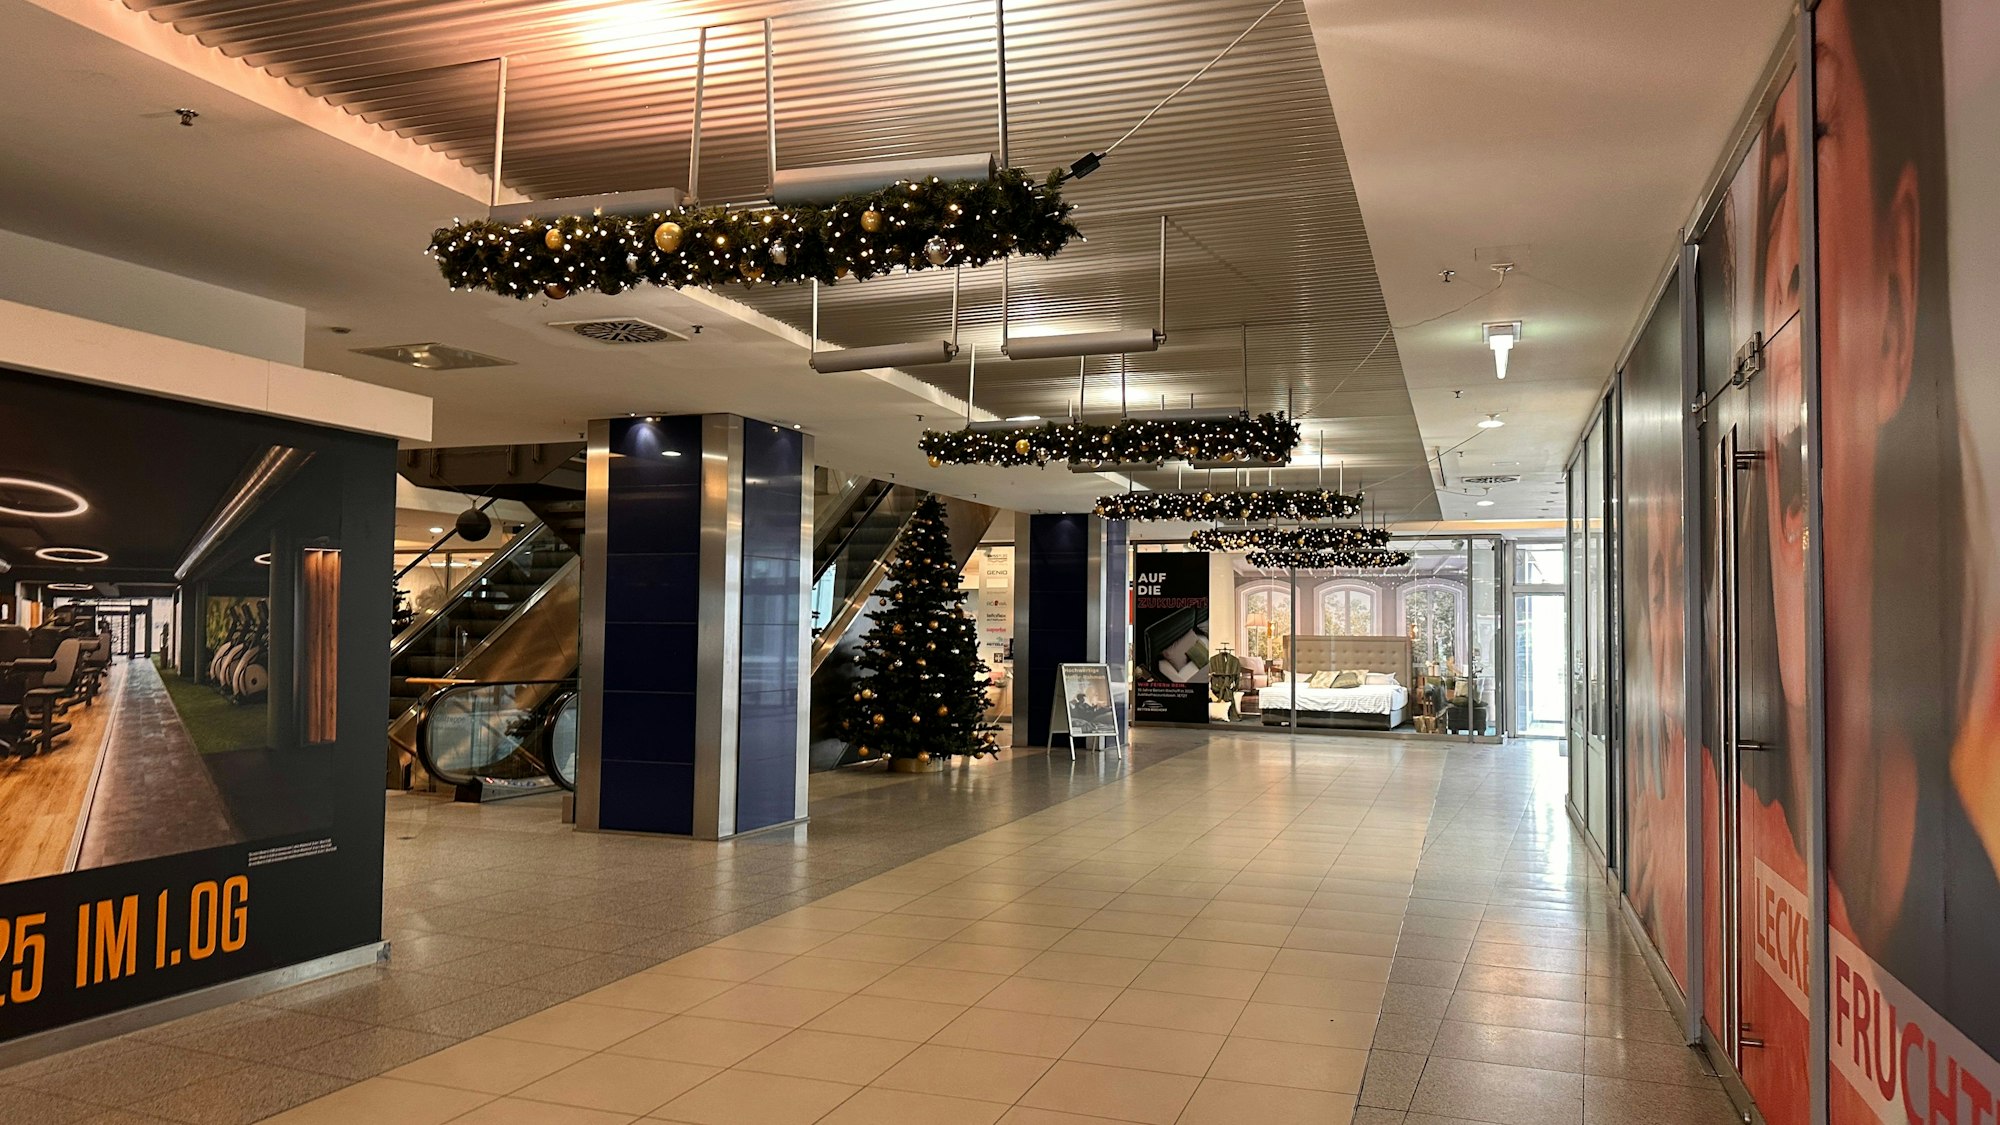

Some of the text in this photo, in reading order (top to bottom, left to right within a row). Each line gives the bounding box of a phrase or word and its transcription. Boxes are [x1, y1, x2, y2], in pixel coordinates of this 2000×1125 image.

[1137, 585, 1161, 596] DIE
[1138, 572, 1167, 583] AUF
[76, 894, 139, 989] IM
[1835, 955, 2000, 1125] FRUCHT
